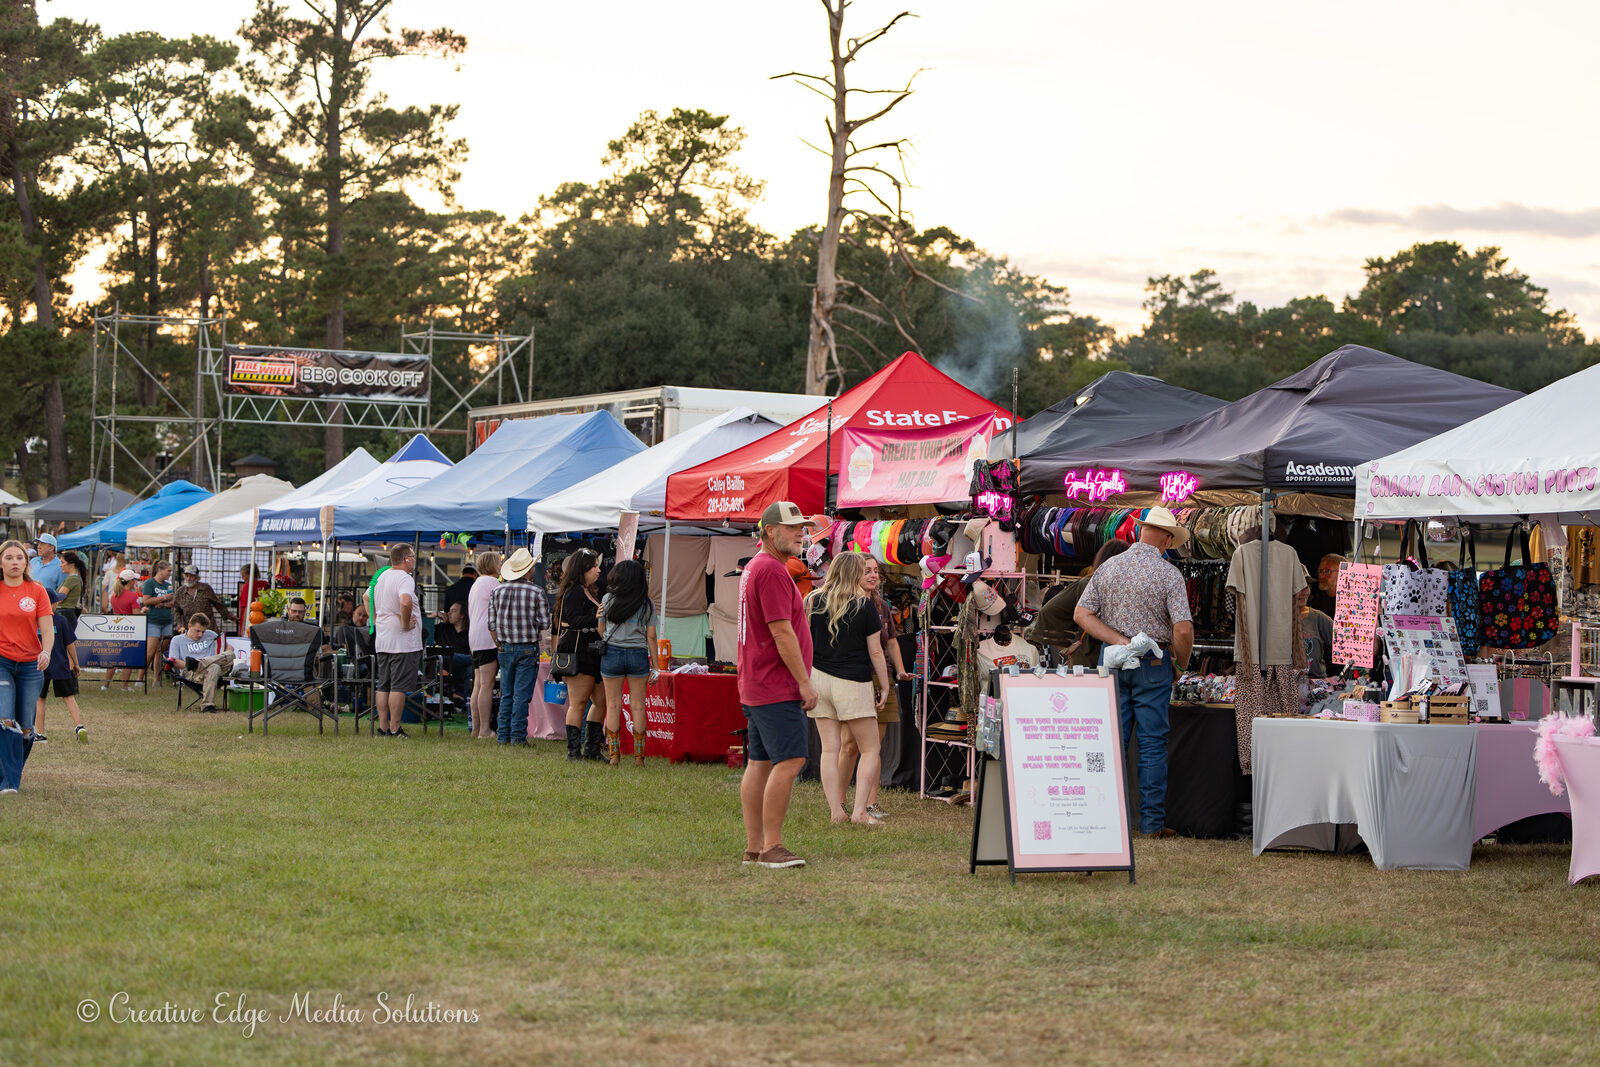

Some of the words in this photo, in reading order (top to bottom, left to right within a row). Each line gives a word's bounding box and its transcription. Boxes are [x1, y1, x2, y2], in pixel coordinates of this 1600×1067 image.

[235, 360, 259, 370] TIRE
[259, 366, 292, 375] WHEEL
[232, 373, 292, 383] CONNECTION
[300, 366, 338, 386] BBQ
[339, 368, 388, 386] COOK
[388, 370, 424, 388] OFF
[866, 410, 941, 426] State
[882, 442, 918, 462] CREATE
[920, 439, 943, 460] YOUR
[944, 438, 964, 457] OWN
[1286, 460, 1356, 480] Academy
[896, 470, 919, 489] HAT
[918, 470, 938, 488] BAR
[1370, 475, 1425, 498] CHARM
[1428, 474, 1462, 497] BAR
[1474, 471, 1539, 497] CUSTOM
[1545, 466, 1598, 494] PHOTO
[262, 518, 270, 531] WE
[269, 518, 283, 531] BUILD
[283, 518, 291, 531] ON
[291, 518, 304, 530] YOUR
[304, 517, 316, 530] LAND
[1062, 786, 1086, 796] EACH
